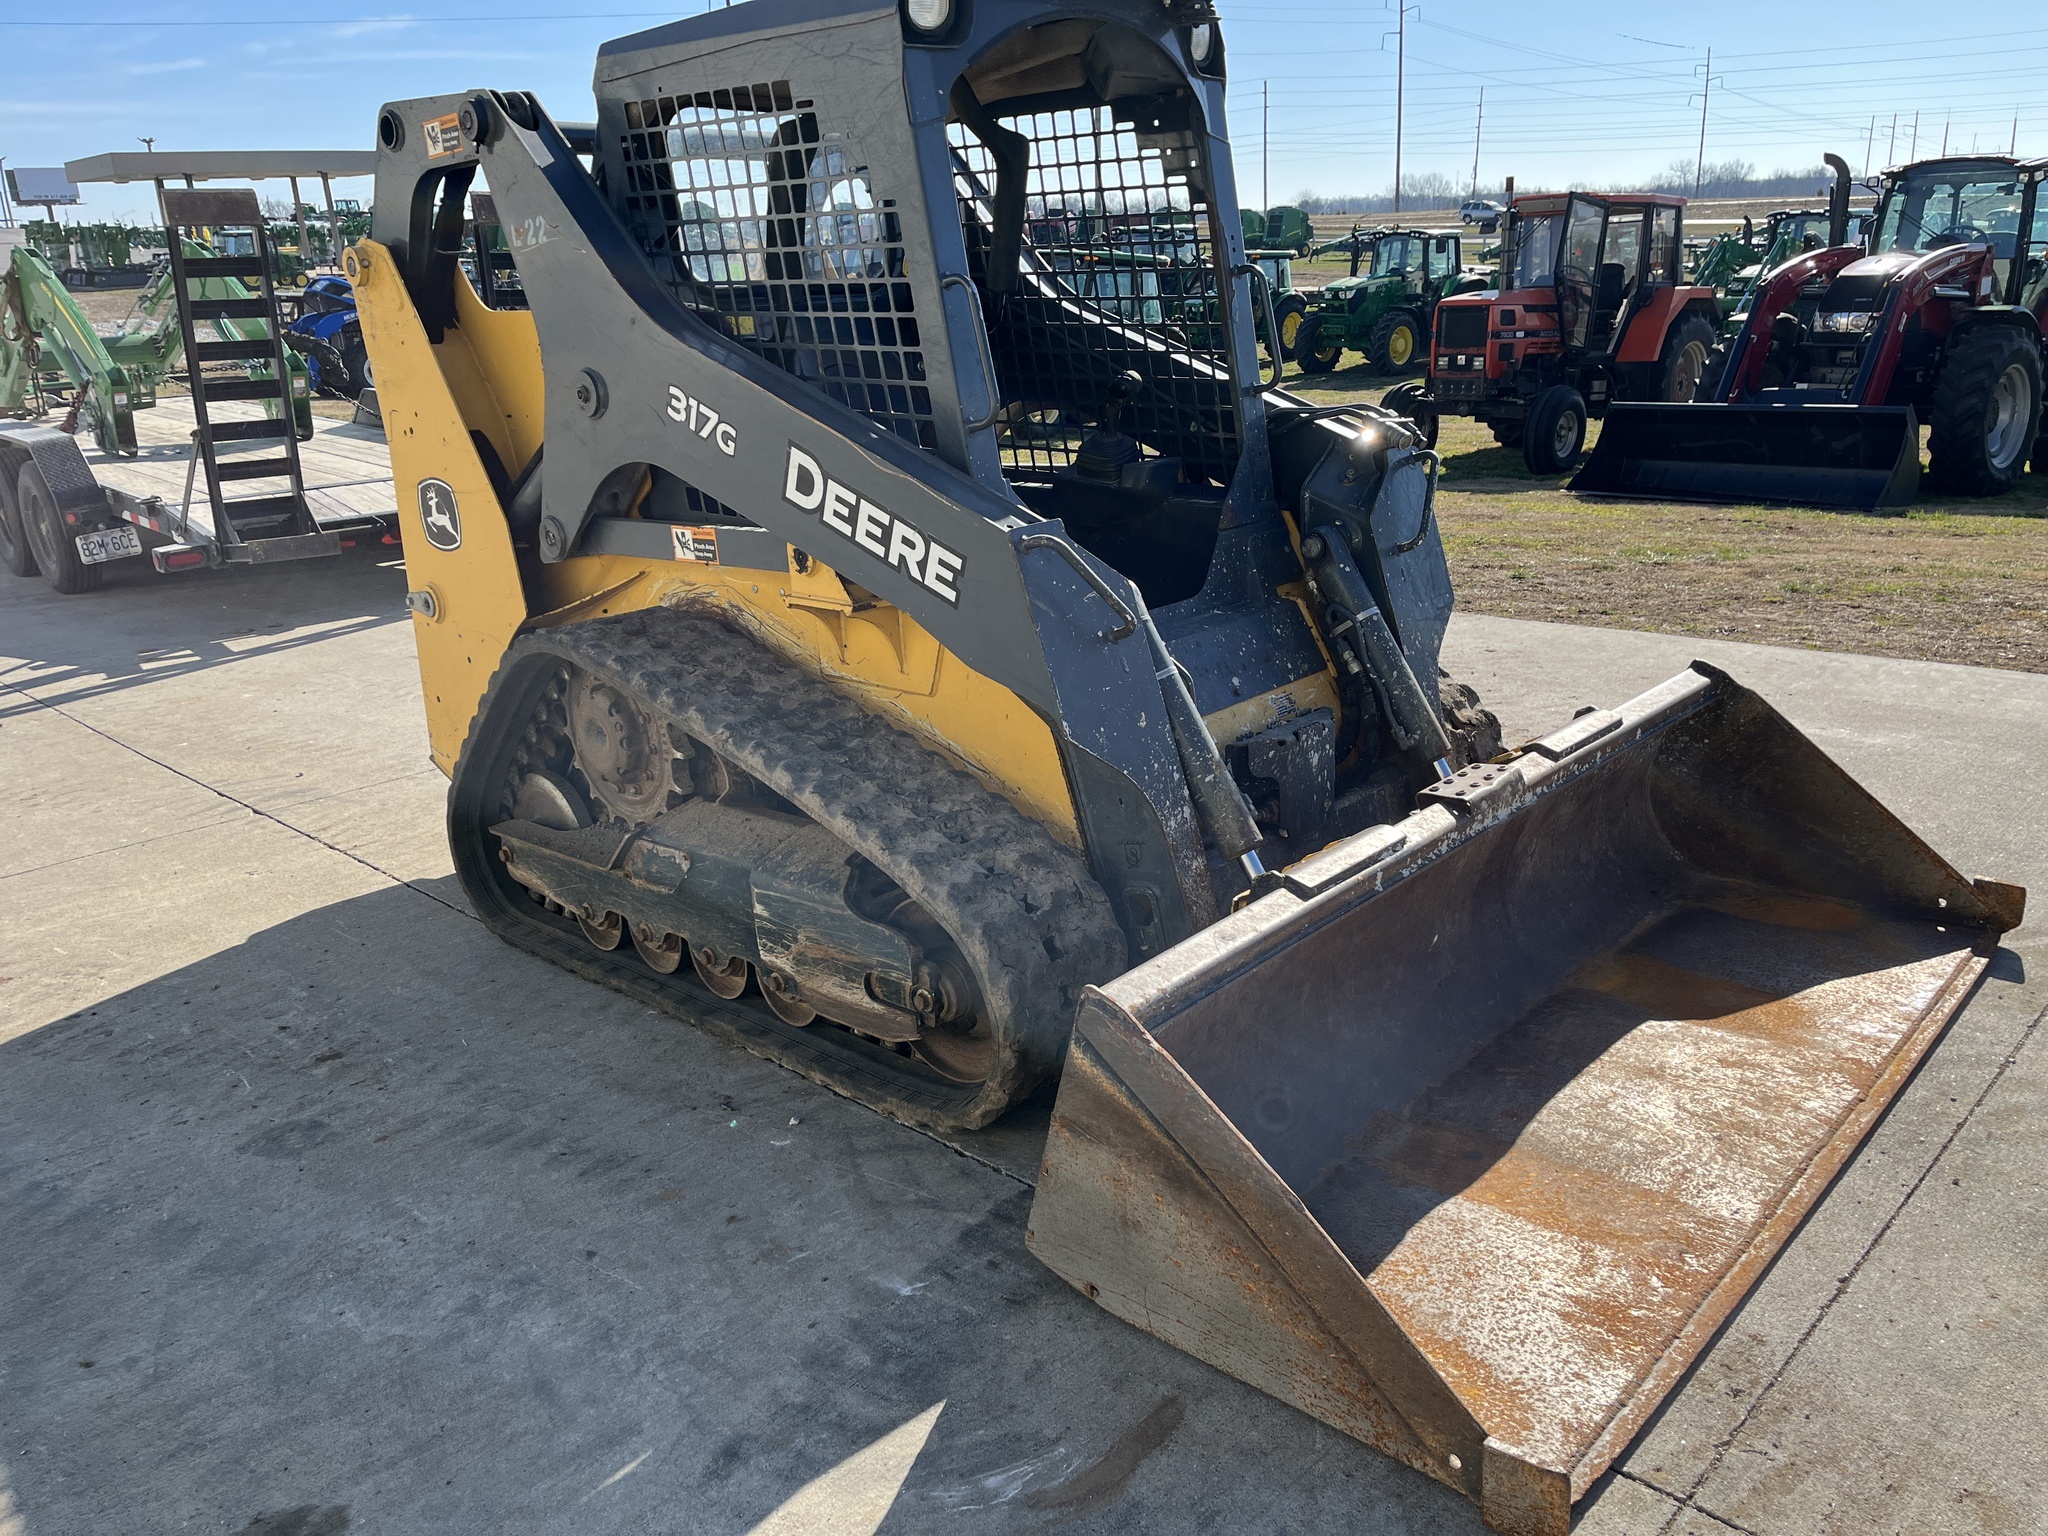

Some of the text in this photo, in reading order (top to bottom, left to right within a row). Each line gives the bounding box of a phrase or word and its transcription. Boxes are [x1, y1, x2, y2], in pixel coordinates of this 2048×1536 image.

[666, 384, 738, 457] 317G
[785, 445, 964, 604] DEERE
[693, 542, 715, 551] Pinch Area
[703, 551, 713, 559] Away
